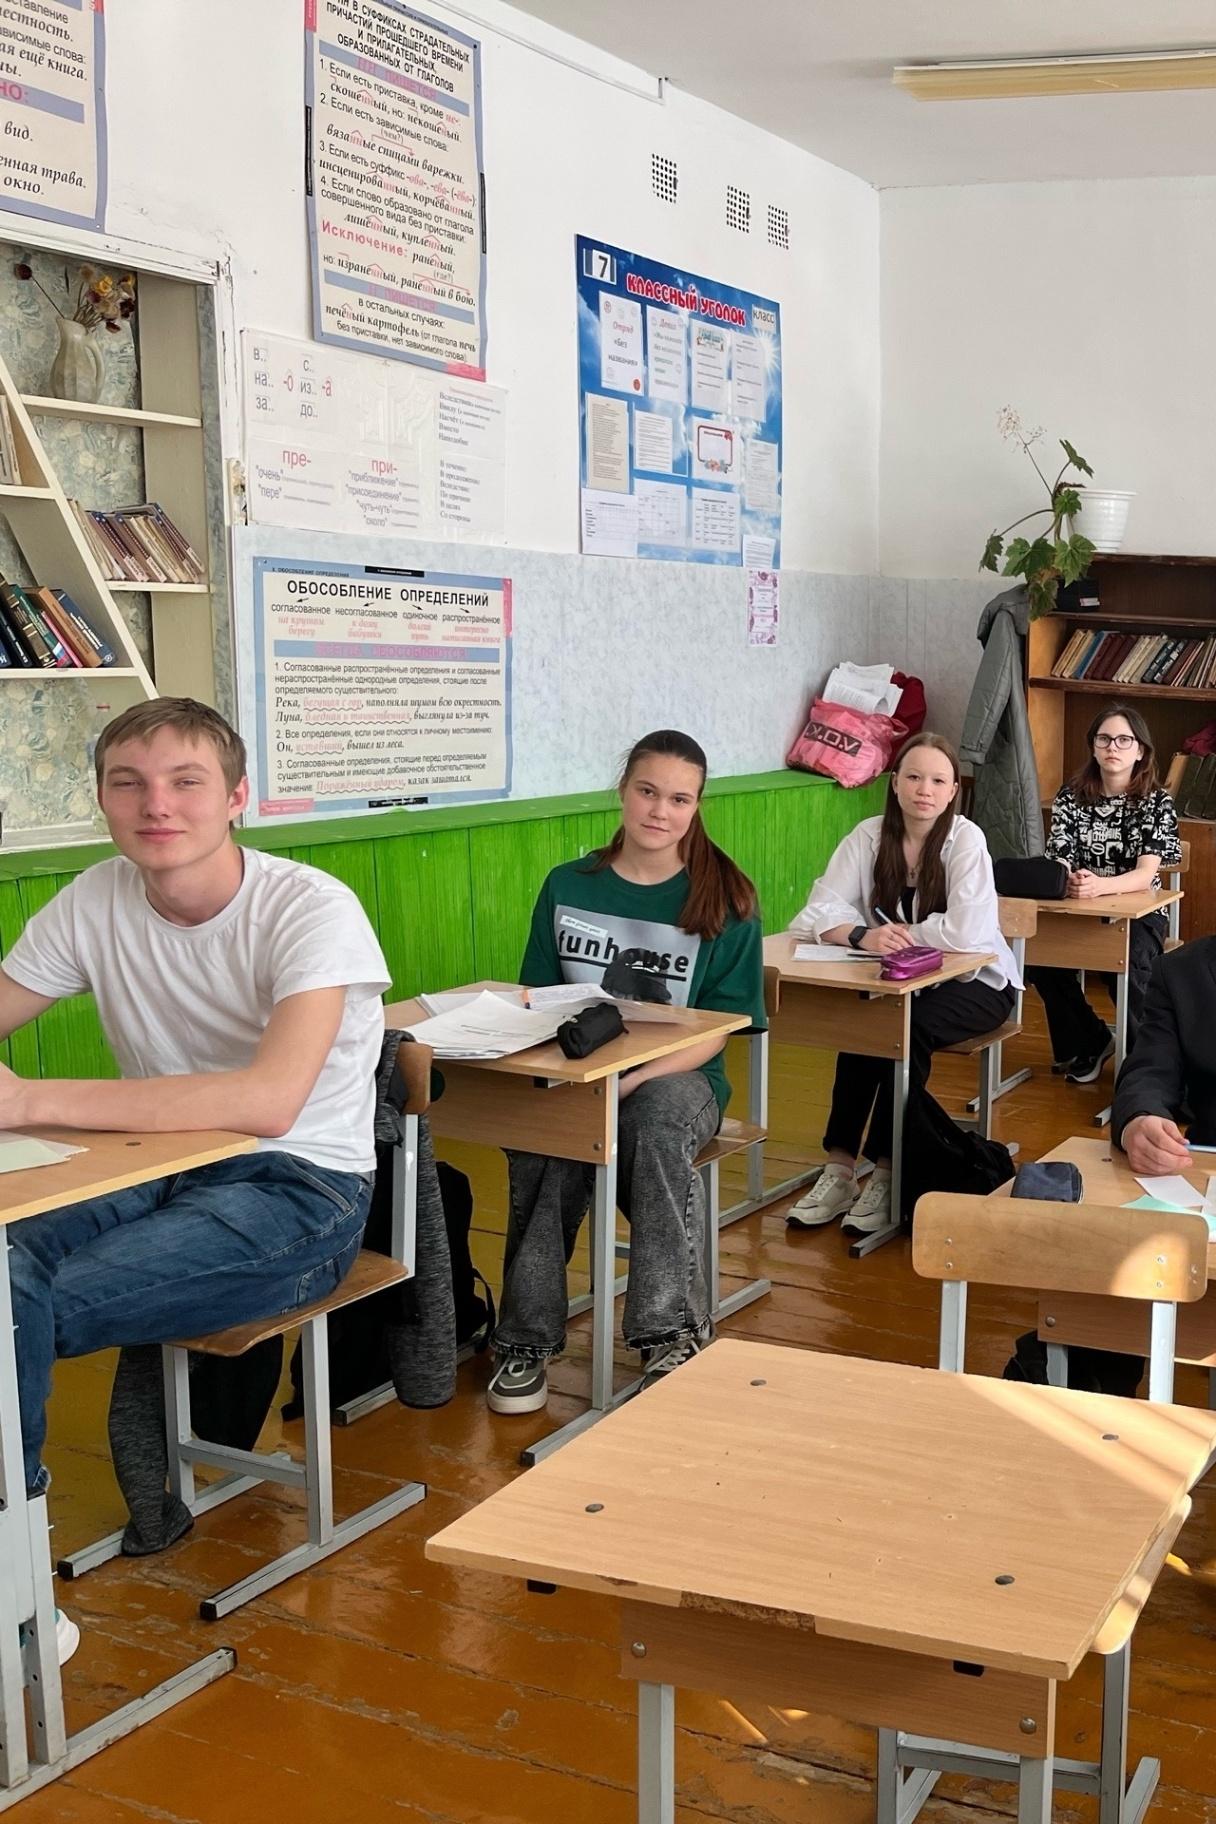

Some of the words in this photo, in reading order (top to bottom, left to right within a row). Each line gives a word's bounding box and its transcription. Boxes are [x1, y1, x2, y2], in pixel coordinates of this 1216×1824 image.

[326, 2, 373, 32] ПРИЧАСТИЙ
[376, 24, 428, 56] ПРОШЕДШЕГО
[431, 51, 463, 72] ВРЕМЕНИ
[362, 4, 407, 34] СУФФИКСАХ
[410, 28, 469, 62] СТРАДАТЕЛЬНЫХ
[19, 49, 45, 66] ещё
[47, 58, 87, 81] книга.
[338, 33, 401, 71] ОБРАЗОВАННЫХ
[404, 64, 414, 75] ОТ
[417, 68, 454, 92] ГЛАГОЛОВ
[330, 62, 351, 80] Если
[353, 75, 372, 89] есть
[420, 103, 444, 119] кроме
[331, 97, 353, 114] Если
[355, 109, 374, 122] есть
[376, 117, 421, 142] зависимые
[4, 121, 33, 142] вид.
[329, 143, 349, 160] Если
[351, 153, 369, 167] есть
[371, 160, 405, 181] суффикс
[378, 144, 420, 167] спицами
[4, 176, 44, 195] окно.
[41, 171, 86, 188] трава.
[321, 189, 384, 216] совершенного
[386, 209, 407, 224] вида
[408, 214, 422, 229] без
[332, 178, 354, 195] Если
[356, 189, 382, 204] слово
[384, 195, 432, 221] образовано
[434, 213, 444, 223] от
[445, 217, 474, 236] глагола
[322, 219, 408, 257] Исключение:
[598, 255, 608, 278] 7
[367, 300, 410, 320] остальных
[627, 273, 698, 313] КЛАССНЫЙ
[700, 296, 746, 327] УГОЛОК
[337, 321, 349, 330] без
[367, 316, 420, 338] картофель
[283, 451, 311, 469] пре-
[372, 460, 397, 476] при-
[287, 580, 392, 600] ОБОСОБЛЕНИЕ
[400, 588, 489, 606] ОПРЕДЕЛЕНИЙ
[271, 603, 331, 615] согласованное
[335, 608, 398, 618] несогласованное
[402, 612, 438, 621] одиночное
[284, 662, 341, 672] Согласованные
[275, 686, 333, 695] определяемого
[276, 697, 300, 708] Река,
[275, 712, 302, 725] Луна,
[285, 730, 299, 738] Все
[277, 742, 293, 752] Он,
[287, 759, 345, 768] Согласованные
[277, 770, 345, 782] существительным
